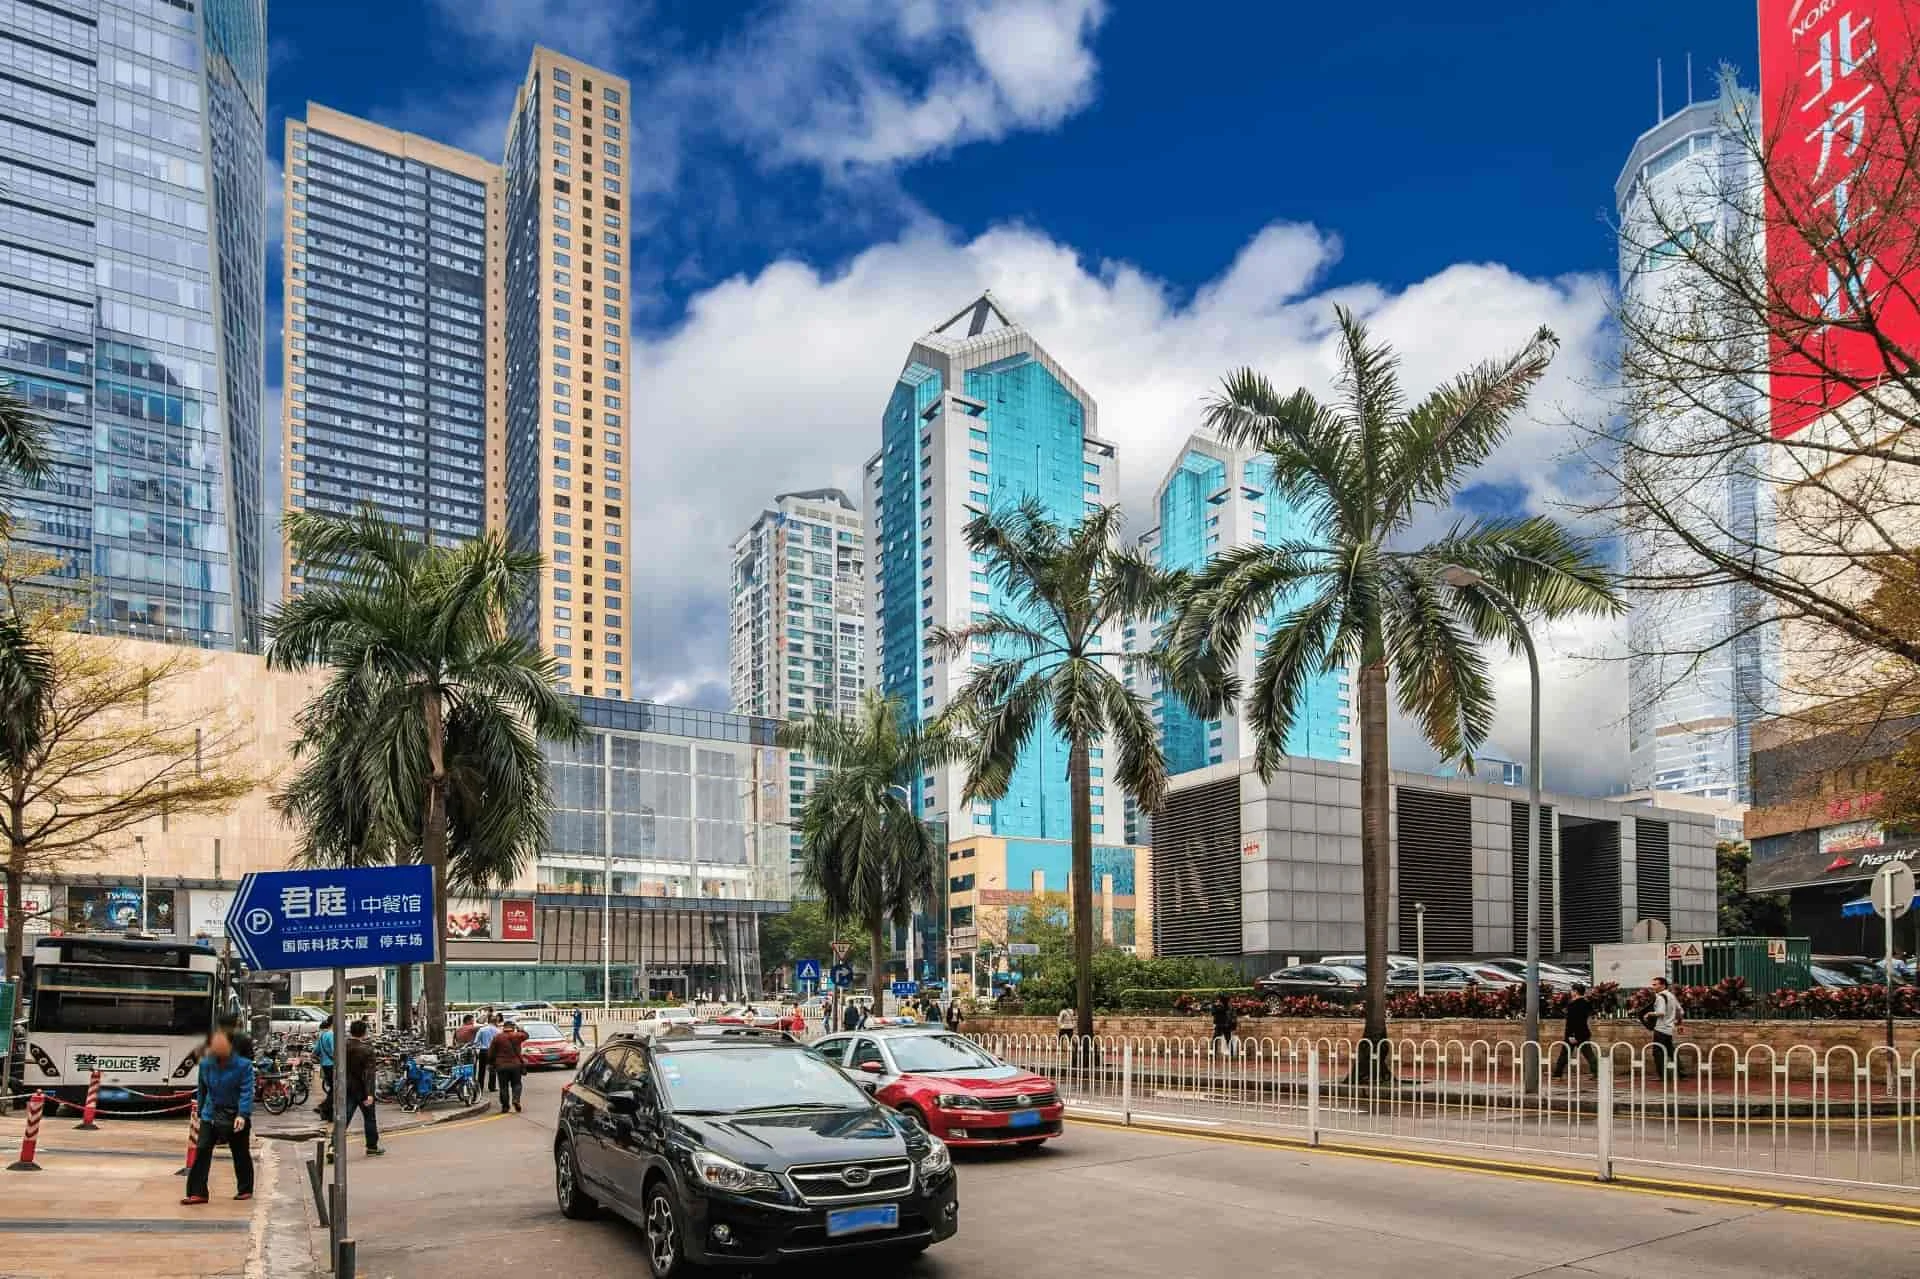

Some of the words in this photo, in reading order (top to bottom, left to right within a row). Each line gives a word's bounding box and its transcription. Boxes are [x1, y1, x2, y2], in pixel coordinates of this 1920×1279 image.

[1791, 0, 1836, 44] NOR
[1859, 854, 1892, 868] Pizza
[1893, 848, 1920, 861] Hut
[280, 885, 348, 919] 君庭
[361, 894, 422, 914] 中餐馆
[282, 936, 369, 953] 国际科技大厦
[380, 933, 423, 949] 停车场
[74, 1054, 98, 1072] 警
[99, 1058, 137, 1070] POLICE
[139, 1056, 161, 1073] 察
